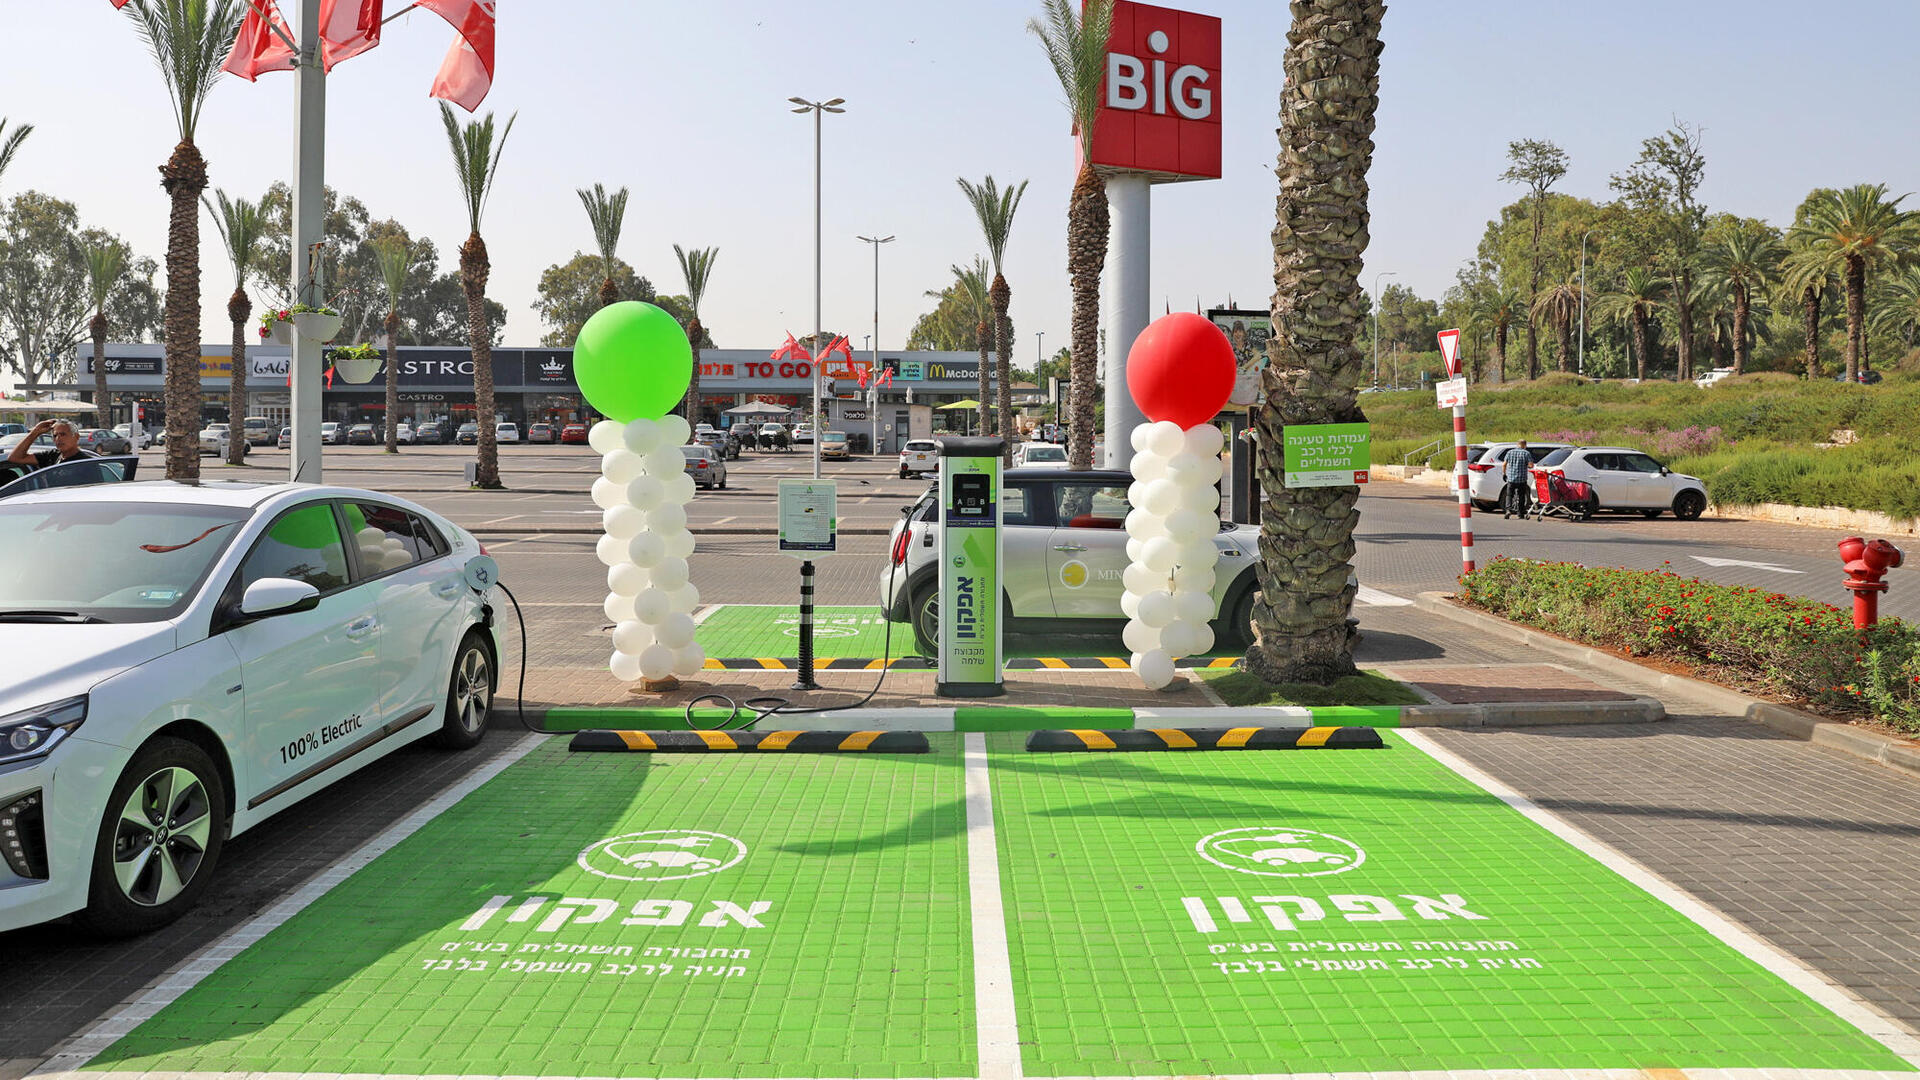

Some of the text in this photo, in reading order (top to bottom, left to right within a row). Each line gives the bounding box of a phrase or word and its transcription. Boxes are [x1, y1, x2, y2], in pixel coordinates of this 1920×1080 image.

[378, 361, 475, 375] ASTRO
[745, 362, 774, 378] TO
[779, 362, 811, 378] GO
[1288, 434, 1366, 445] עמדות טעינה
[1301, 445, 1354, 456] לכלי רכב
[1300, 457, 1351, 468] חשמליים
[1098, 569, 1124, 580] MIN
[957, 576, 977, 638] אפקון
[954, 648, 985, 656] מקבוצת
[961, 657, 985, 665] שלמה
[280, 714, 362, 764] 100% Electric
[458, 895, 773, 932] אפקון
[1180, 894, 1490, 933] אפקון
[518, 940, 634, 955] חשמלית
[1287, 940, 1402, 952] חשמלית
[1413, 940, 1519, 951] תחבורה
[644, 947, 751, 959] תחבורה
[422, 957, 747, 977] חניה לרכב חשמלי בלבד
[1294, 958, 1390, 972] חשמלי
[1400, 956, 1470, 969] לרכב
